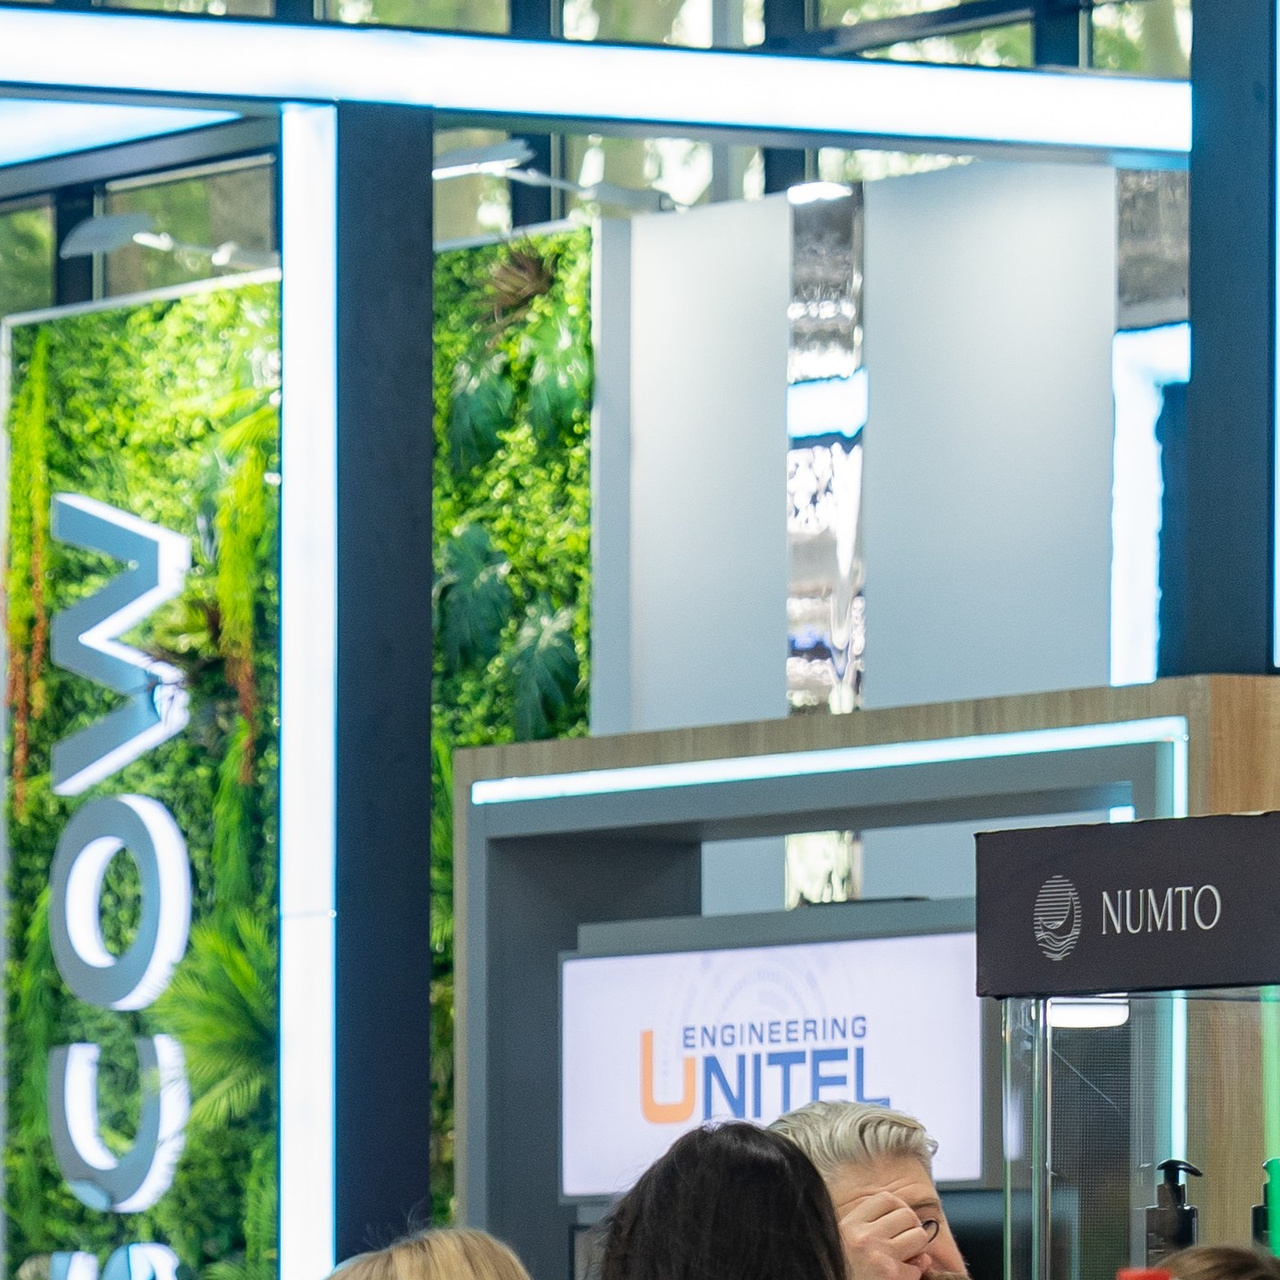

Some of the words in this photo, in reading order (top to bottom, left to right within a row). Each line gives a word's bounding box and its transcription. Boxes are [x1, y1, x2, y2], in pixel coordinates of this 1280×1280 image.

[1101, 883, 1222, 936] NUMTO
[683, 1015, 867, 1049] ENGINEERING
[640, 1029, 890, 1123] UNITEL
